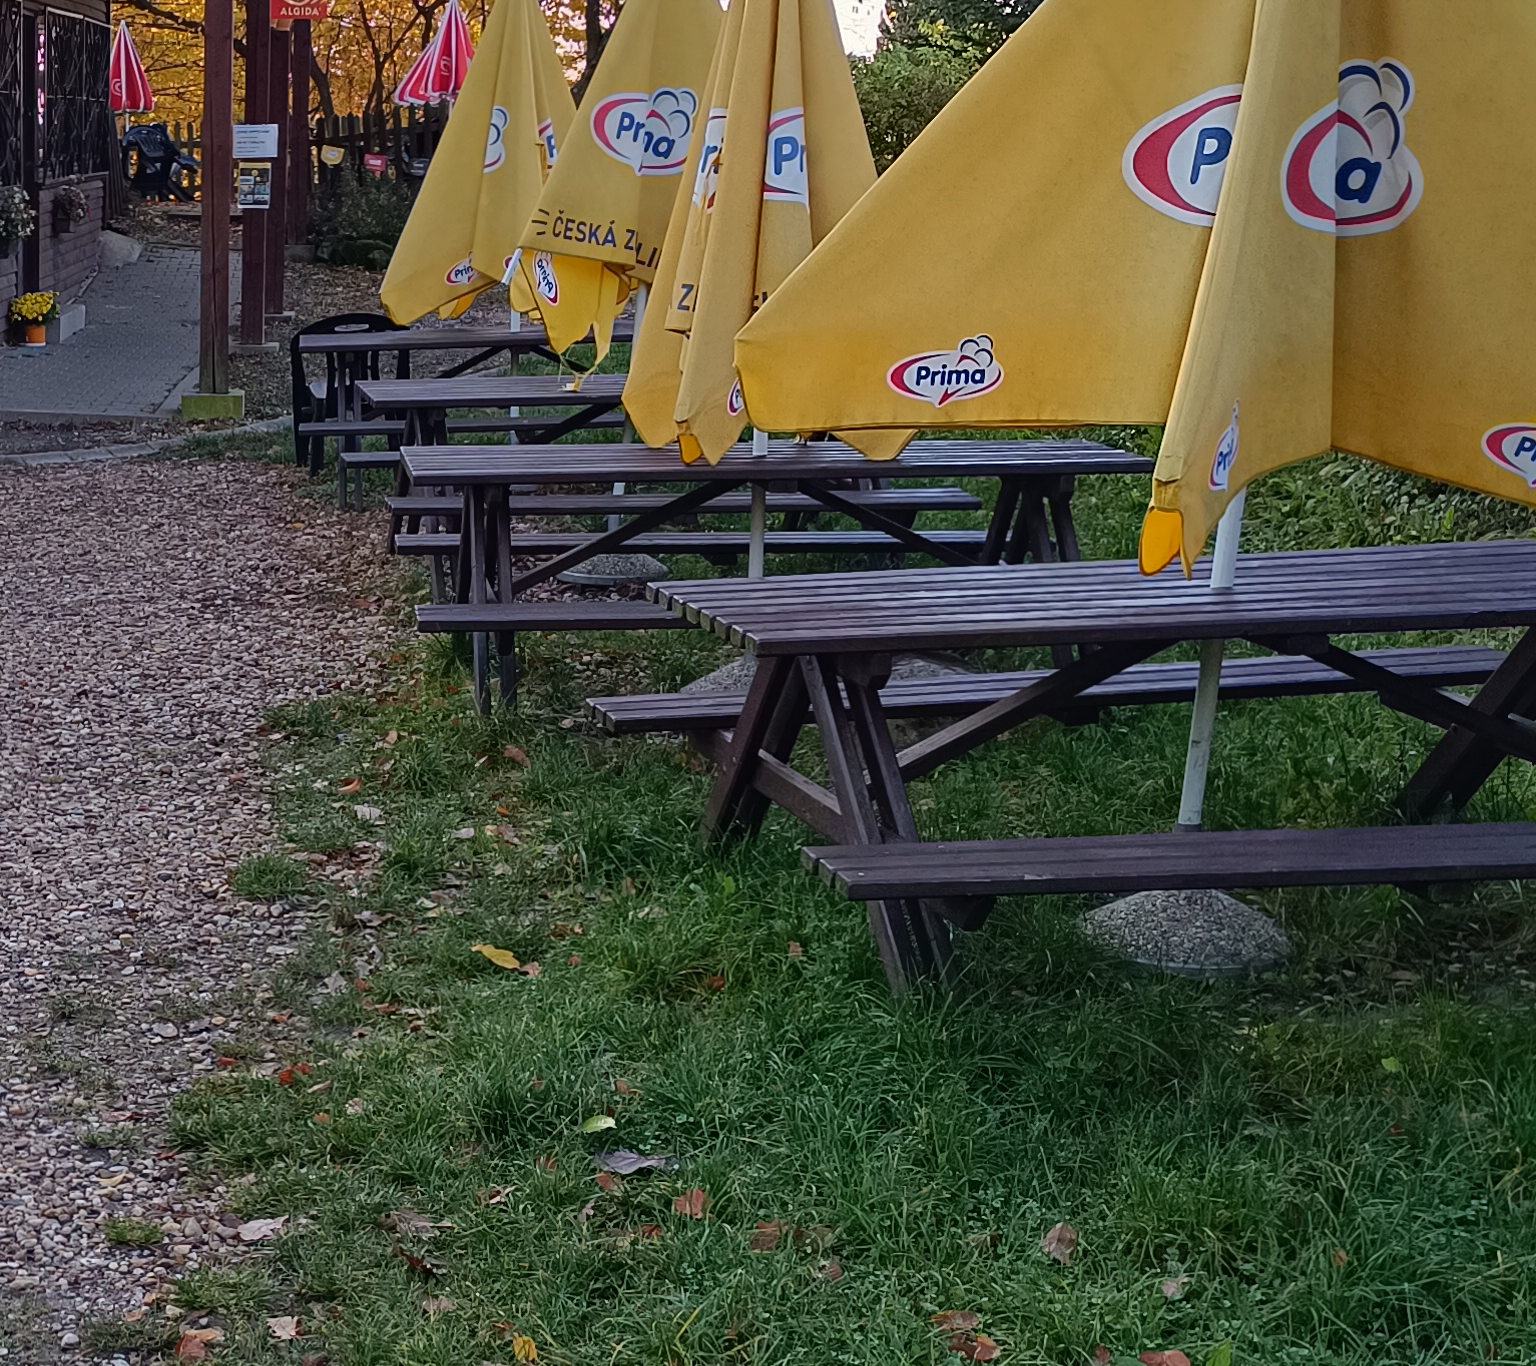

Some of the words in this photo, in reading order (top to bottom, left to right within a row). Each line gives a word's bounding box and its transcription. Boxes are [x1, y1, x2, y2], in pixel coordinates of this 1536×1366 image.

[280, 6, 320, 16] ALGIDA
[552, 209, 616, 248] ČESKÁ
[915, 363, 986, 387] Prima
